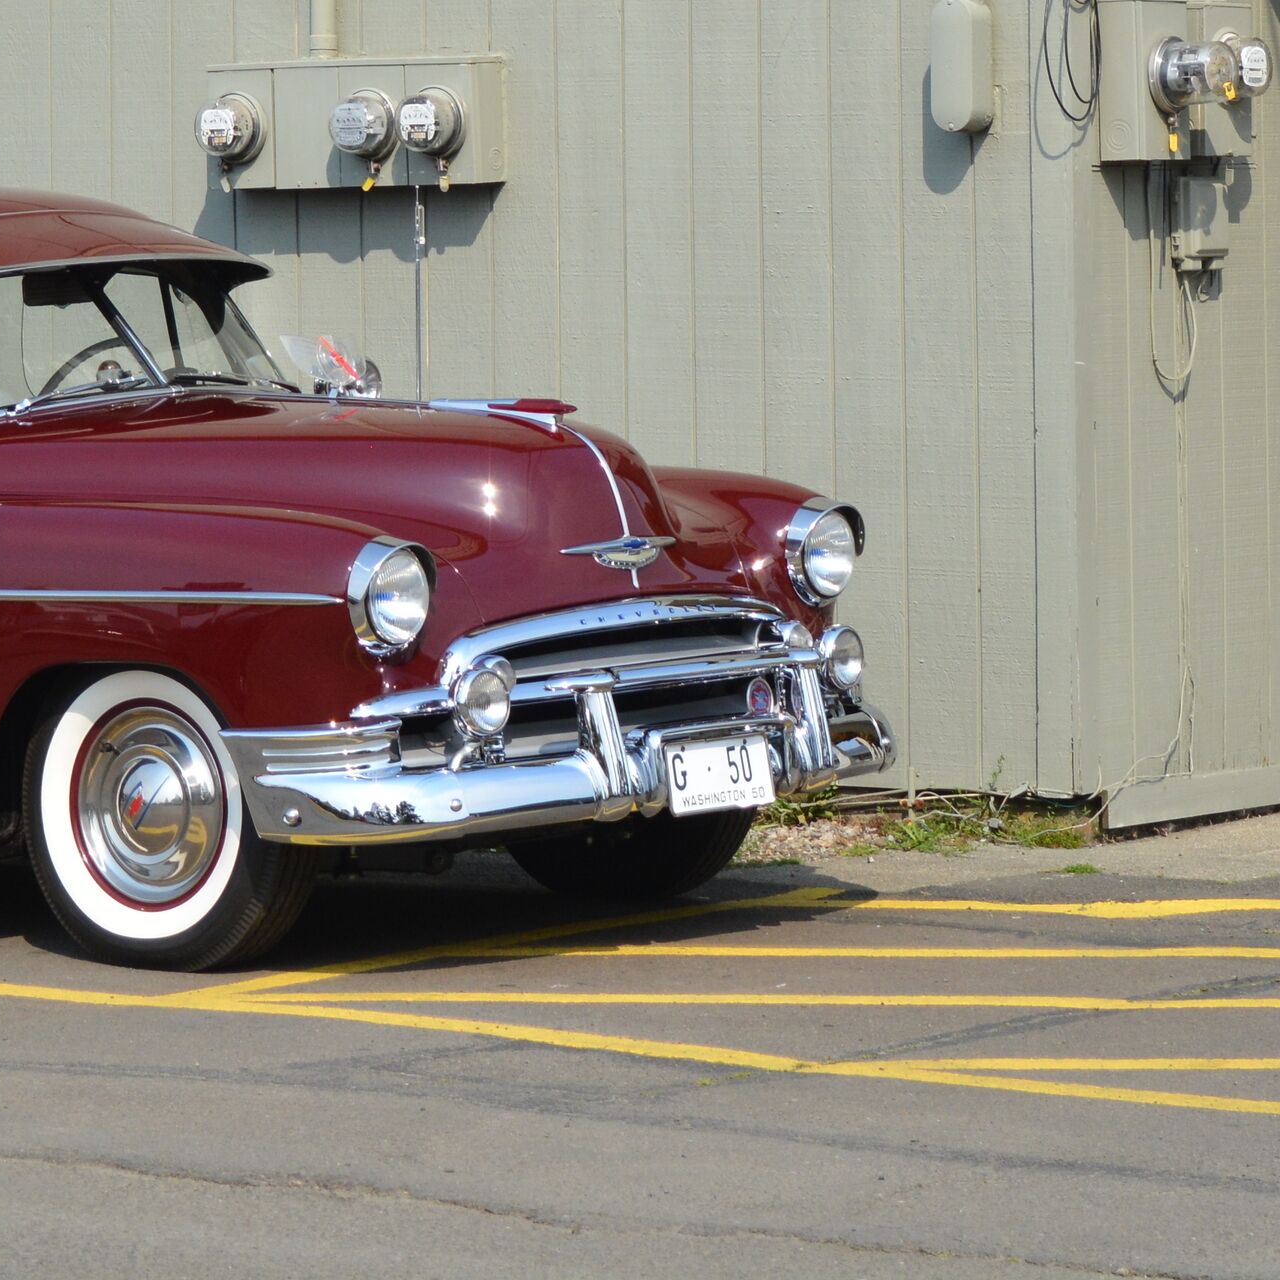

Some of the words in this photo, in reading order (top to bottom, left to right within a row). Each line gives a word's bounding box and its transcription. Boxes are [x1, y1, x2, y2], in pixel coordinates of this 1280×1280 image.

[580, 603, 717, 625] CHEVROLET
[672, 752, 687, 791] G
[726, 745, 752, 783] 50
[682, 789, 746, 807] WASHINGTON
[751, 786, 766, 799] 50
